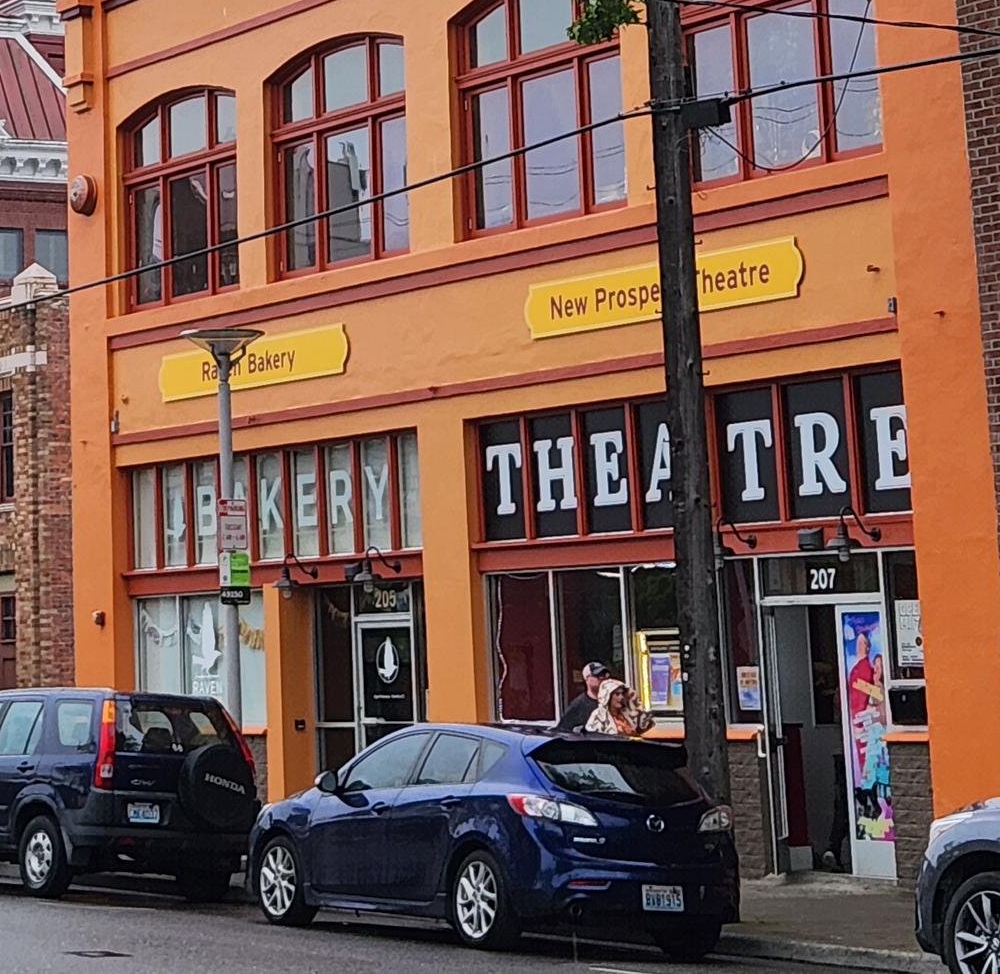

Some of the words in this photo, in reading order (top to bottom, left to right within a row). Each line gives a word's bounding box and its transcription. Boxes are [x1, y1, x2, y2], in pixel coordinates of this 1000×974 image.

[550, 295, 588, 320] New
[595, 283, 661, 312] Prospe
[202, 360, 241, 382] Ran
[248, 350, 296, 375] Bakery
[486, 405, 910, 515] THEATRE
[810, 568, 836, 589] 207
[374, 589, 397, 608] 205
[192, 680, 223, 695] RAVEN
[204, 773, 246, 795] HONDA
